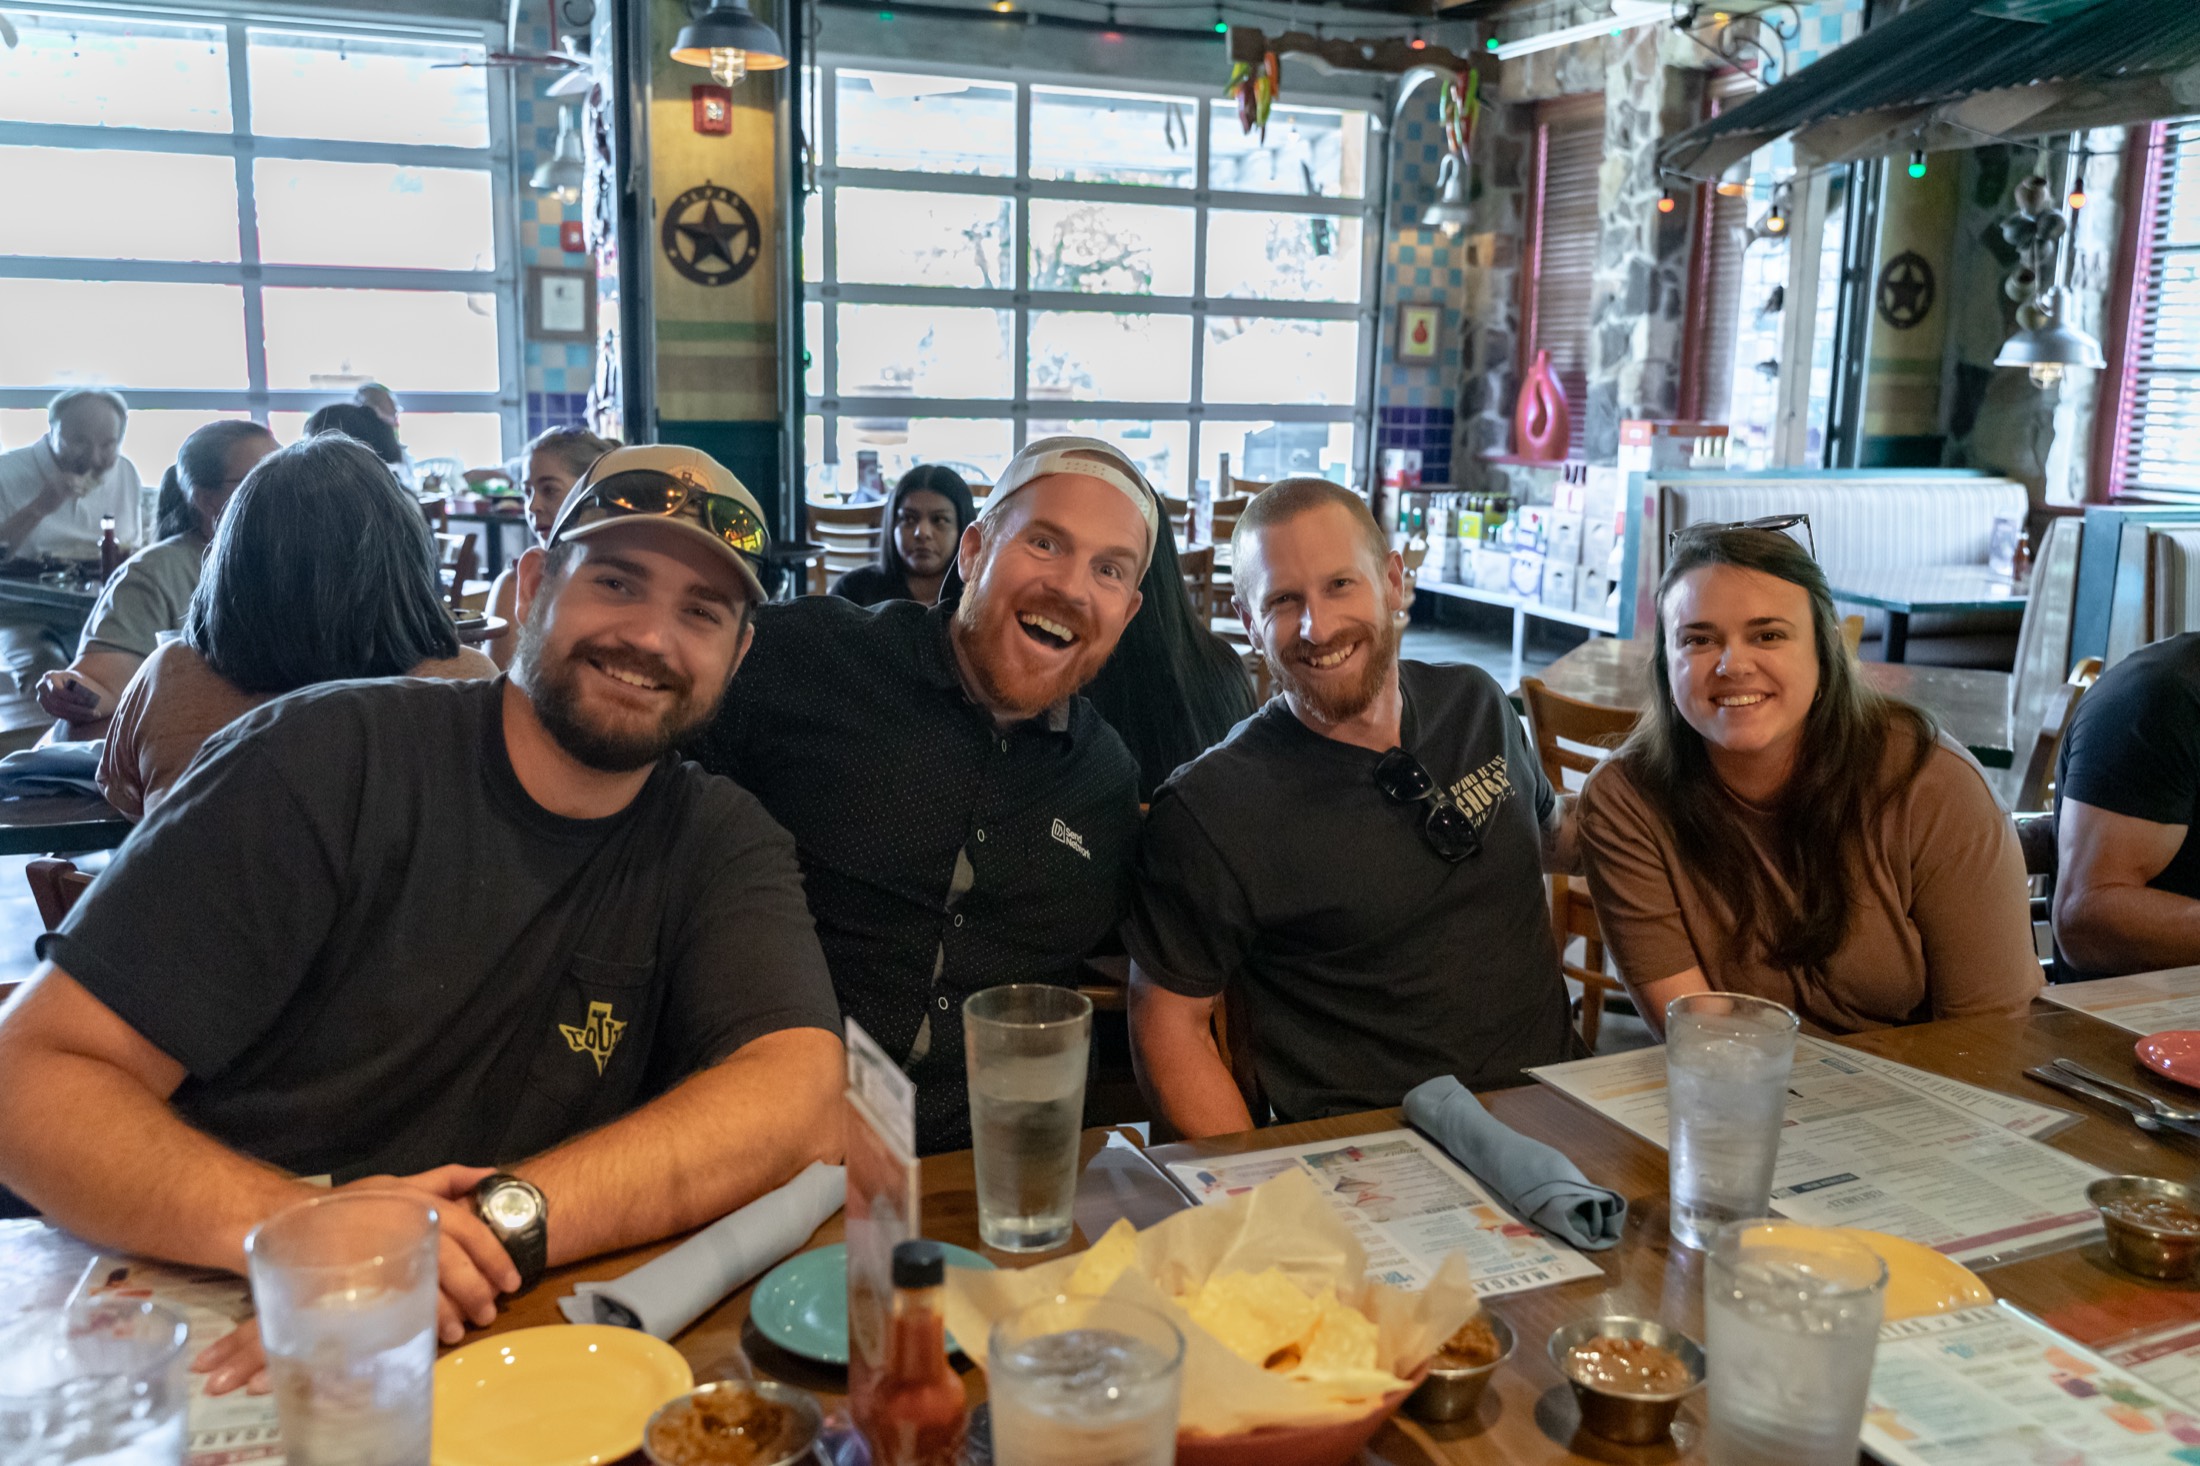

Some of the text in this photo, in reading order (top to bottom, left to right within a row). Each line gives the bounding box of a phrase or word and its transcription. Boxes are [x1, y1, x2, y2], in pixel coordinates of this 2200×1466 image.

[1065, 827, 1083, 845] Send
[1065, 836, 1091, 860] Network
[1473, 1271, 1551, 1293] MARGA
